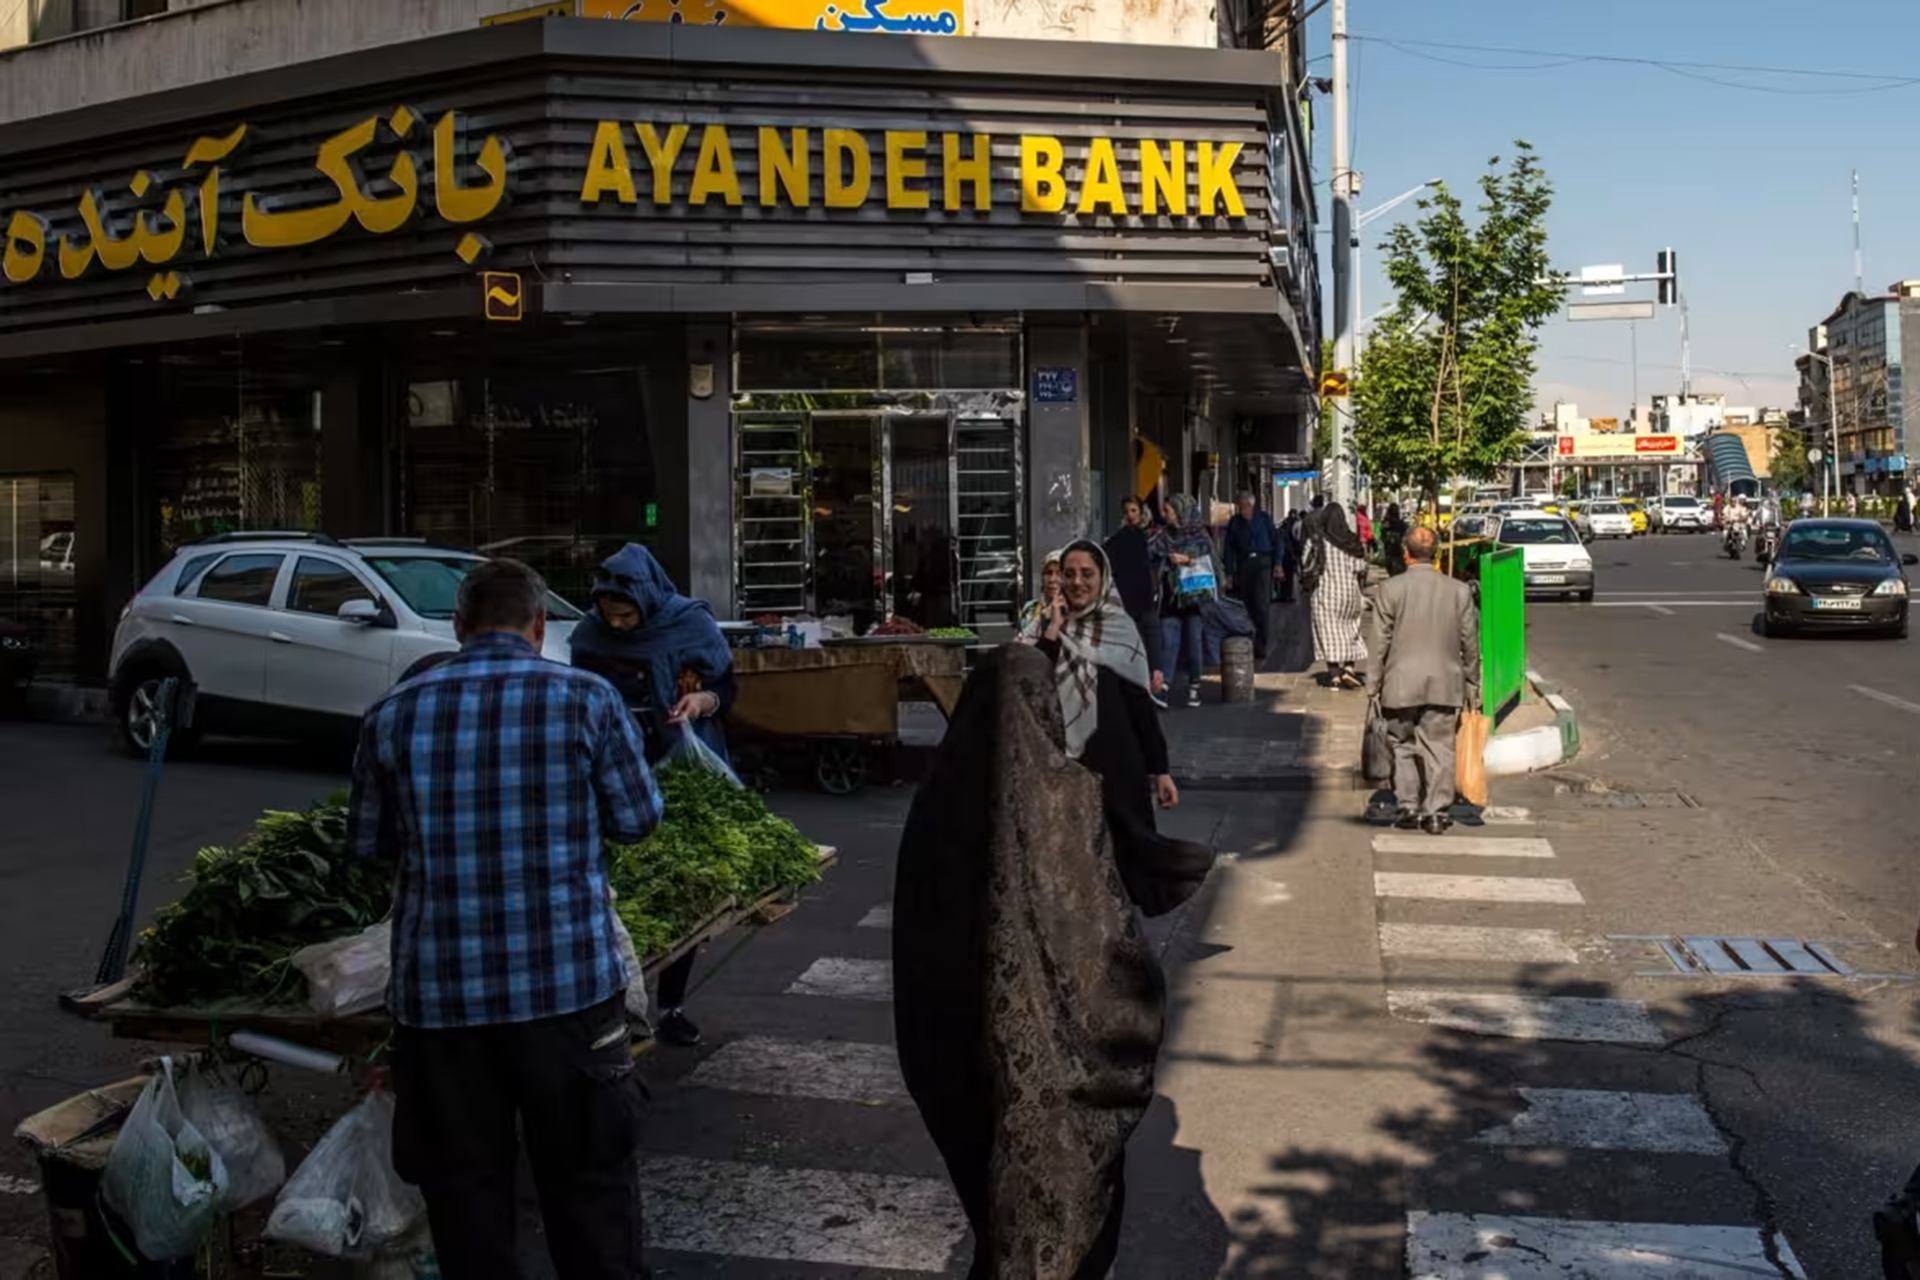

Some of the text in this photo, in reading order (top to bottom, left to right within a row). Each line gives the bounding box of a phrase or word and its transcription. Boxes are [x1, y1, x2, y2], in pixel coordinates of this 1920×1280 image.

[815, 0, 957, 34] مسکن
[3, 105, 506, 300] بانک آینده
[580, 120, 1247, 218] AYANDEH BANK
